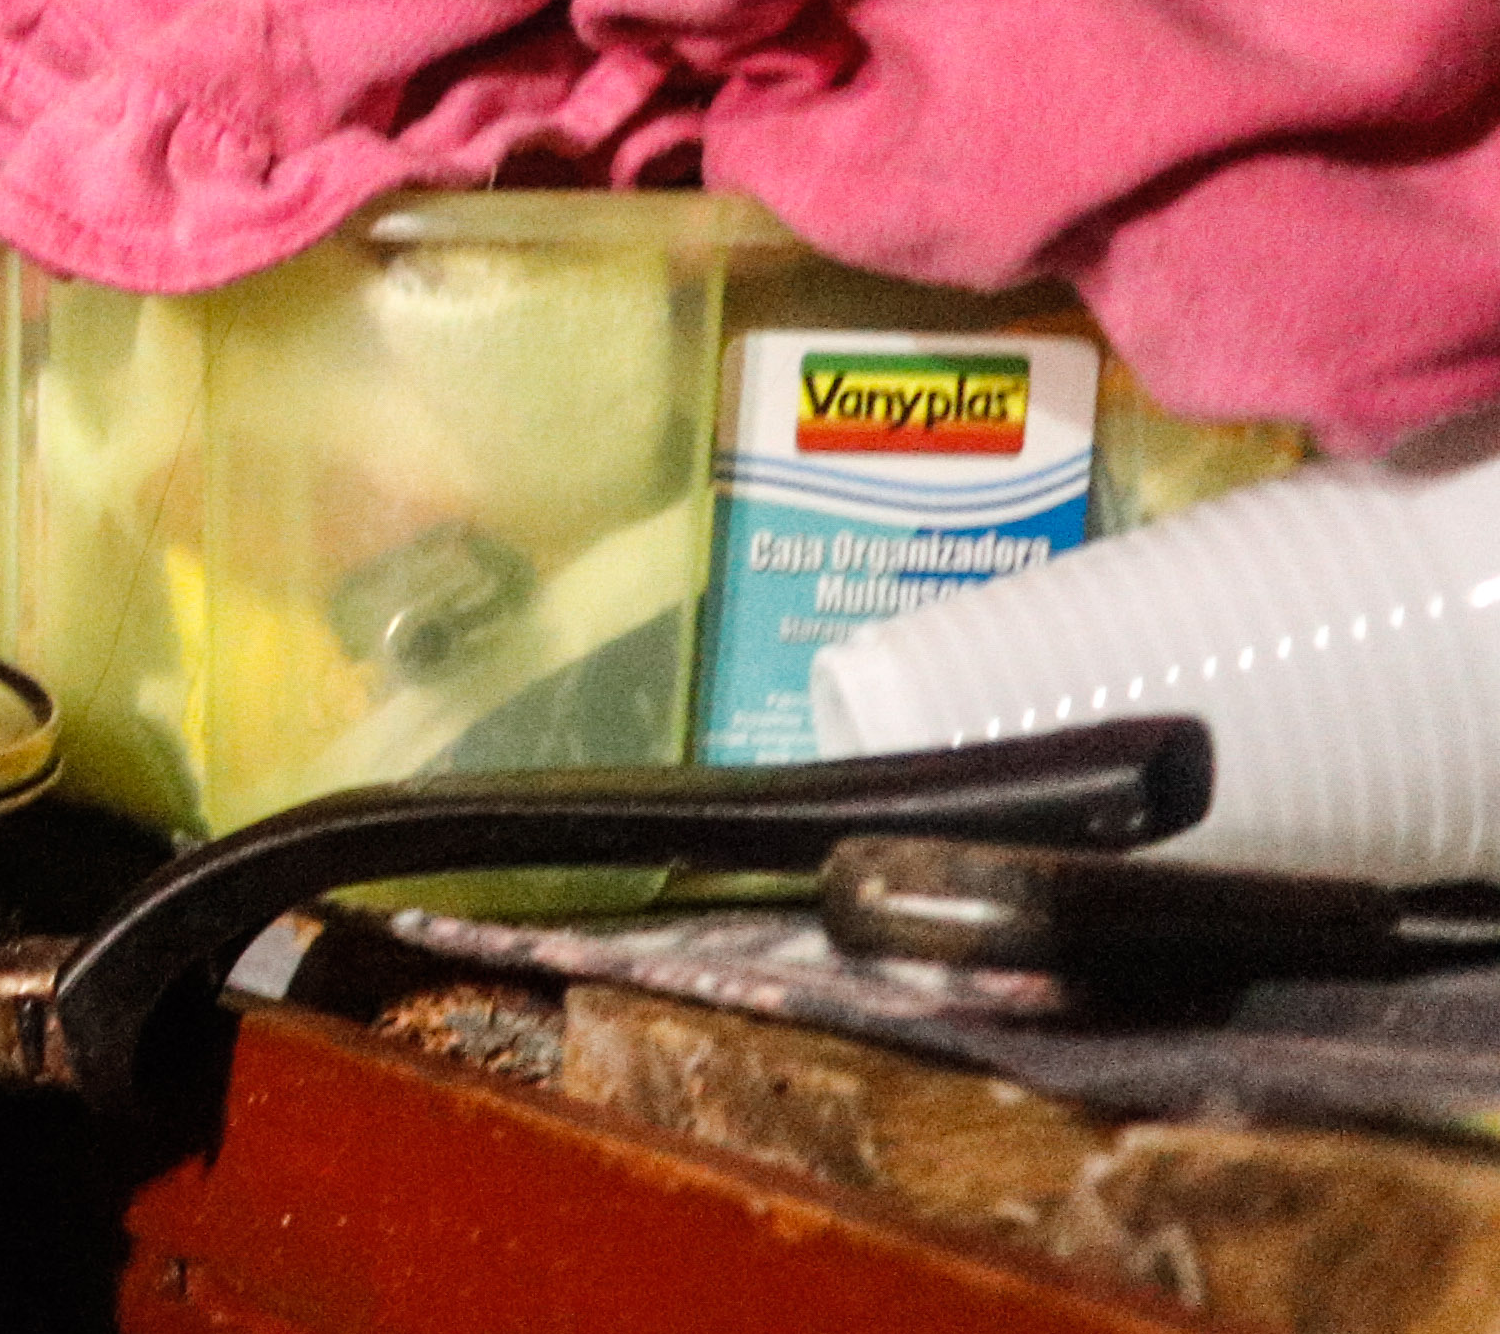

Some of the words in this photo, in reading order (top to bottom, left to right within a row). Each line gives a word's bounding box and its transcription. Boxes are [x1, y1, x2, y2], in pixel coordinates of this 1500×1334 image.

[802, 373, 1012, 429] Vanyplas
[749, 529, 823, 575] Caja
[831, 528, 1051, 574] Organizadora
[815, 573, 972, 615] Multiuso
